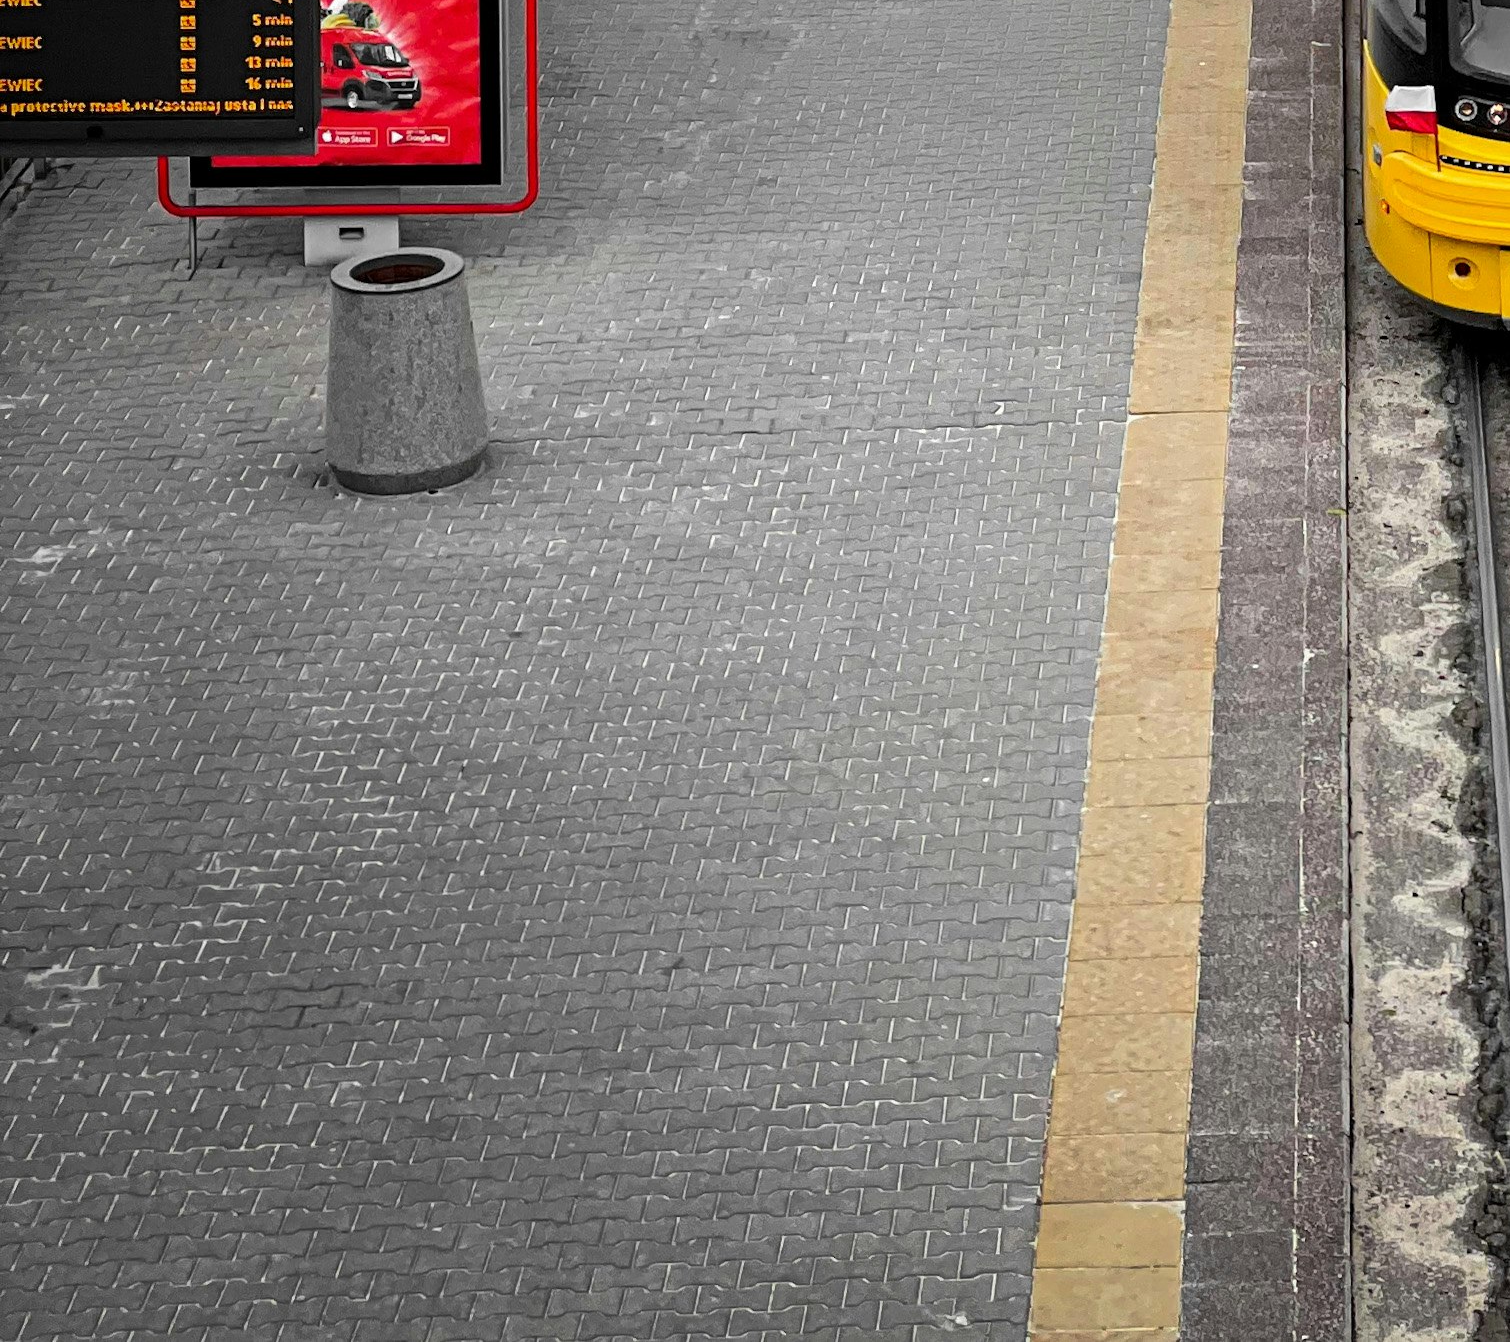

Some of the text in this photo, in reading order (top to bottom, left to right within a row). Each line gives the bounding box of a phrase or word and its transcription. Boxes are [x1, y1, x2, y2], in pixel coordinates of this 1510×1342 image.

[252, 14, 261, 26] 5
[252, 35, 262, 47] 9
[245, 56, 261, 69] 13
[245, 77, 261, 90] 16
[10, 100, 86, 116] protective
[224, 100, 257, 112] usta
[335, 135, 351, 145] App
